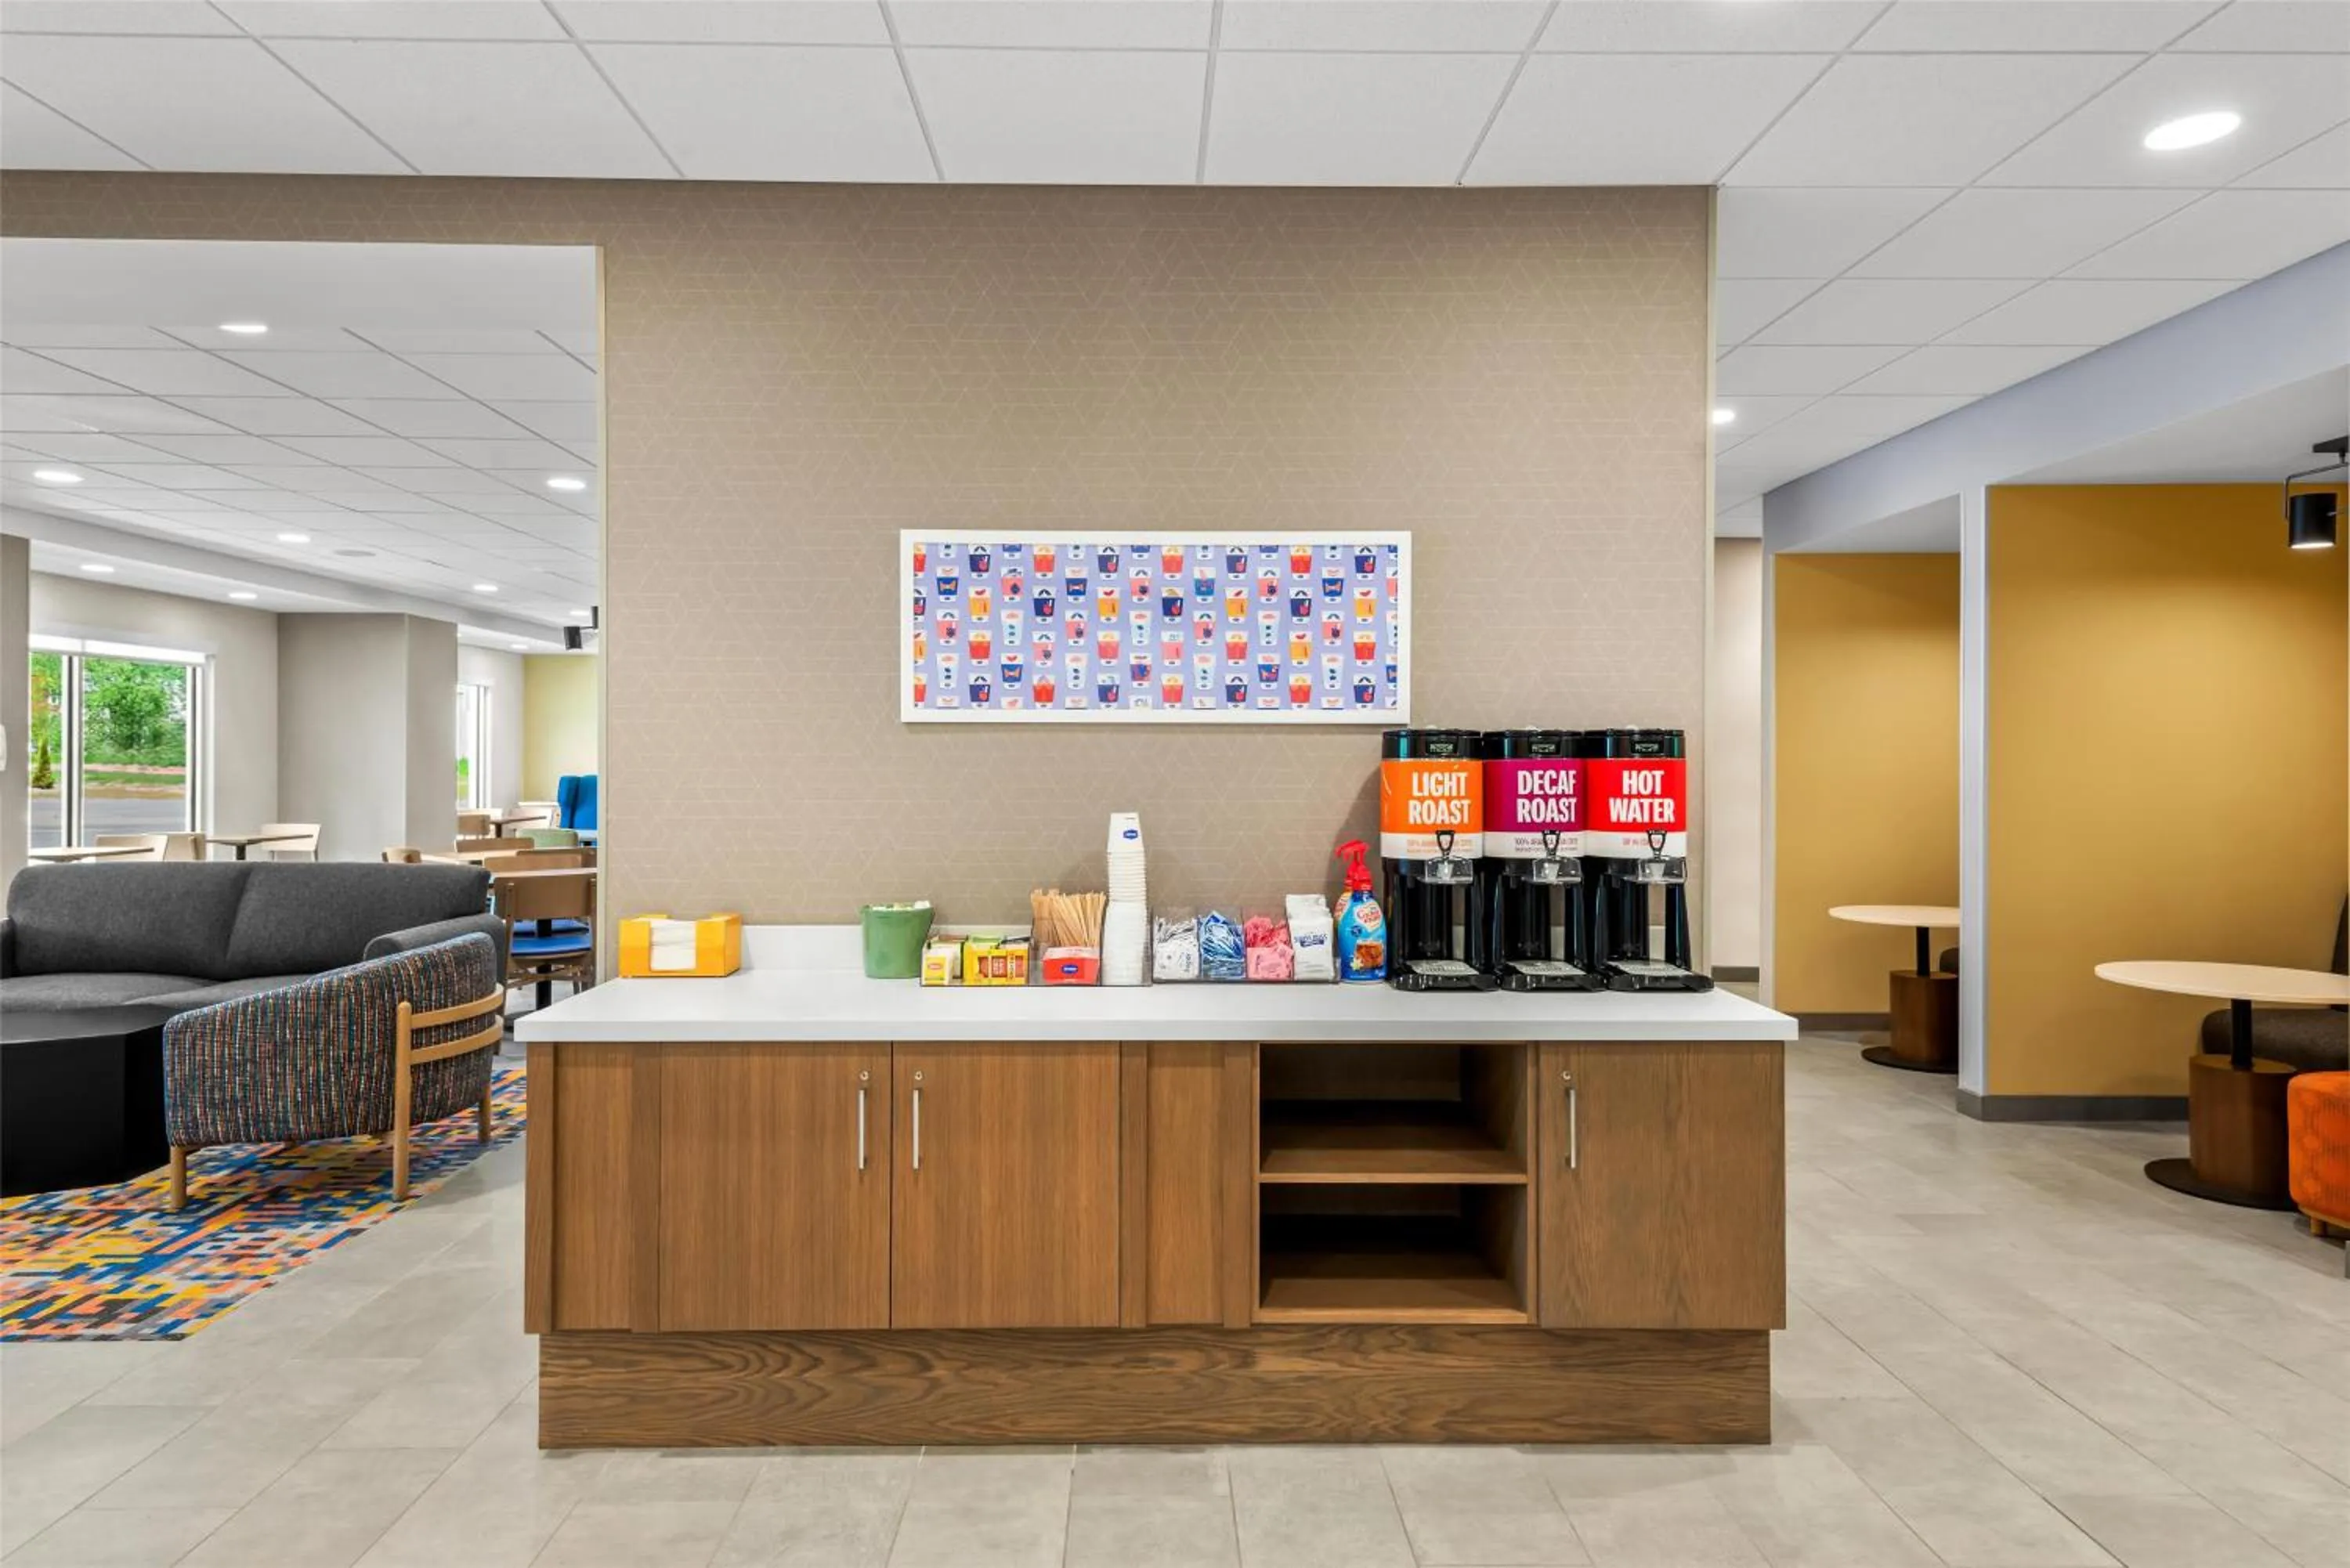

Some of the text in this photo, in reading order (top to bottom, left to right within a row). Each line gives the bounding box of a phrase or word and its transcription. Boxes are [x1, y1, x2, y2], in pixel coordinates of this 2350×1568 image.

[1412, 771, 1468, 797] LIGHT
[1517, 770, 1577, 795] DECAF
[1622, 770, 1665, 795] HOT
[1408, 800, 1471, 825] ROAST
[1517, 798, 1577, 823] ROAST
[1609, 797, 1675, 823] WATER
